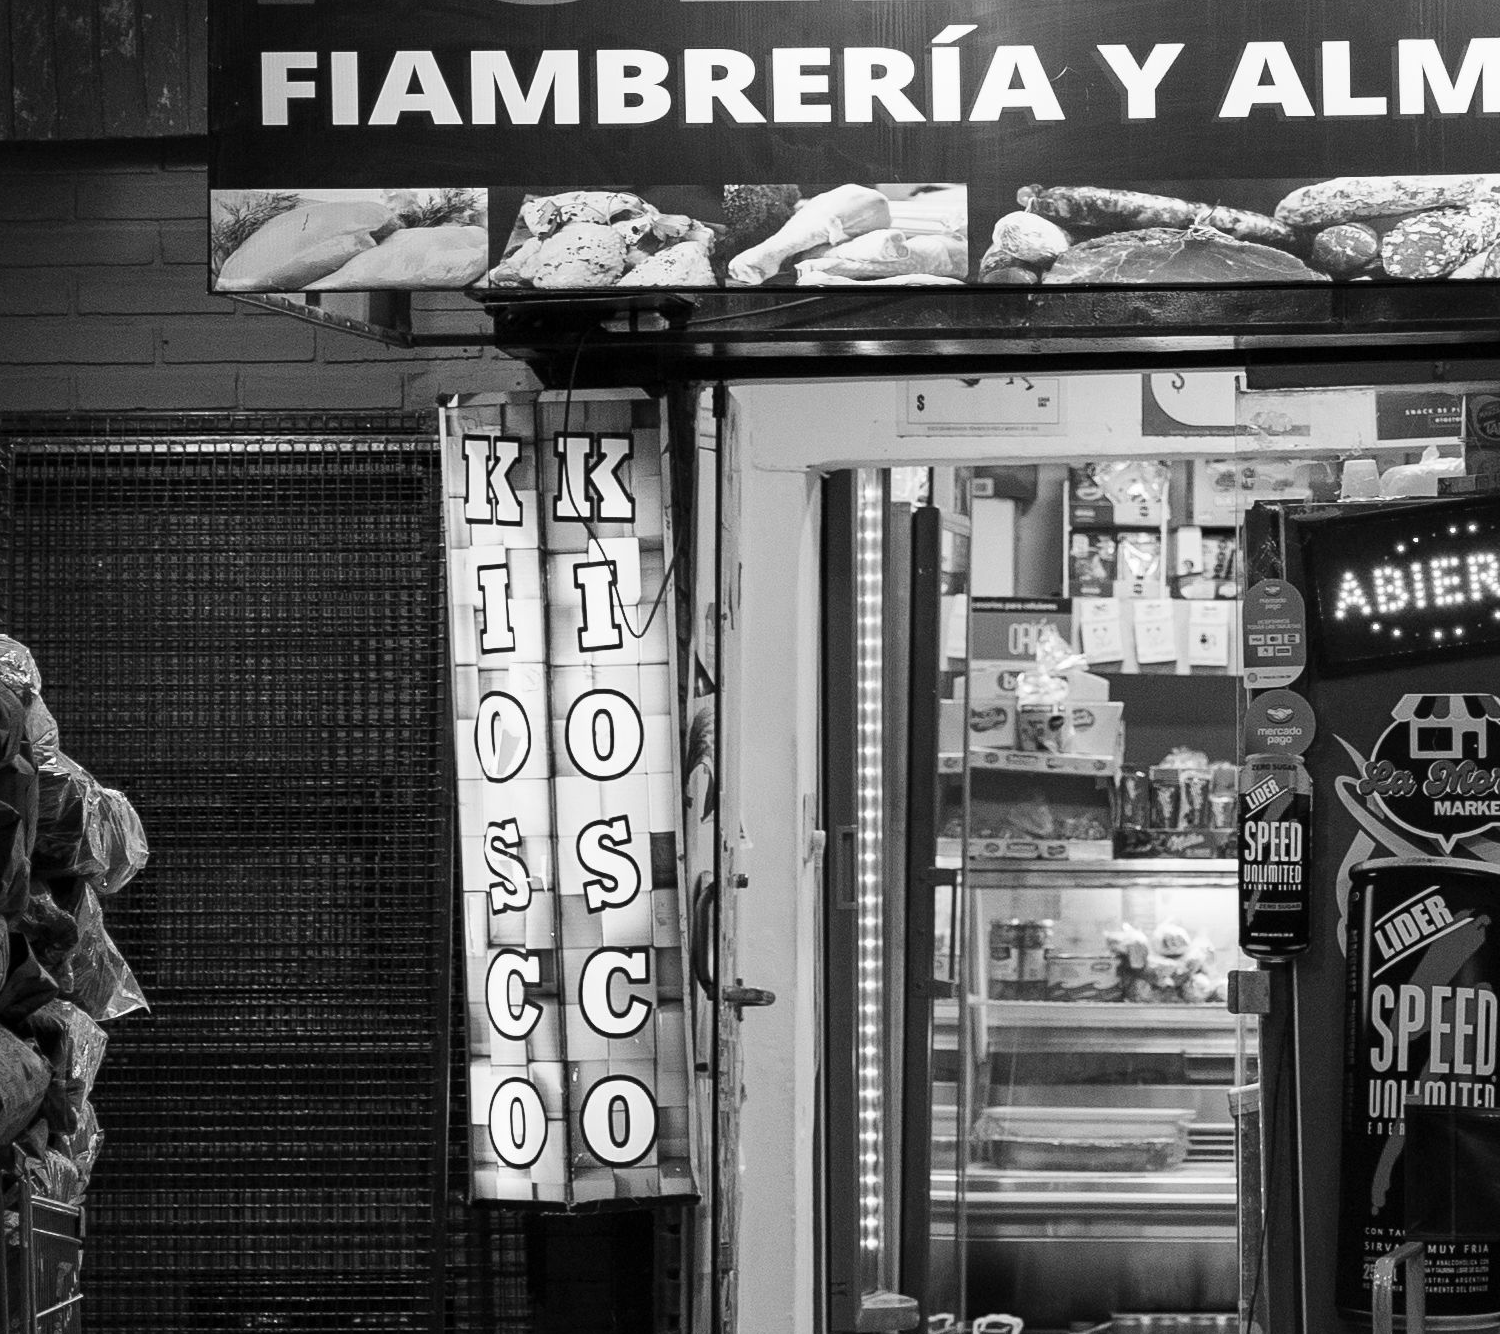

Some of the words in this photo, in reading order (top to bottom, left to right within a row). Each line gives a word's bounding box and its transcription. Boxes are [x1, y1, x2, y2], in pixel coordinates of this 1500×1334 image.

[260, 23, 1066, 128] FIAMBRERÍA
[1103, 40, 1187, 122] Y
[1257, 727, 1302, 736] mercado
[1267, 736, 1292, 746] pago
[1245, 779, 1280, 810] LIDER
[1356, 760, 1417, 799] La
[462, 433, 549, 1169] KIOSCO
[552, 433, 659, 1168] KIOSCO
[1244, 820, 1303, 862] SPEED
[1243, 864, 1302, 883] UNLIMITED
[1374, 894, 1455, 962] LIDER
[1370, 984, 1499, 1077] SPEED
[1364, 1227, 1384, 1235] CON
[1427, 1244, 1456, 1255] MUY
[1463, 1243, 1490, 1254] FRIA
